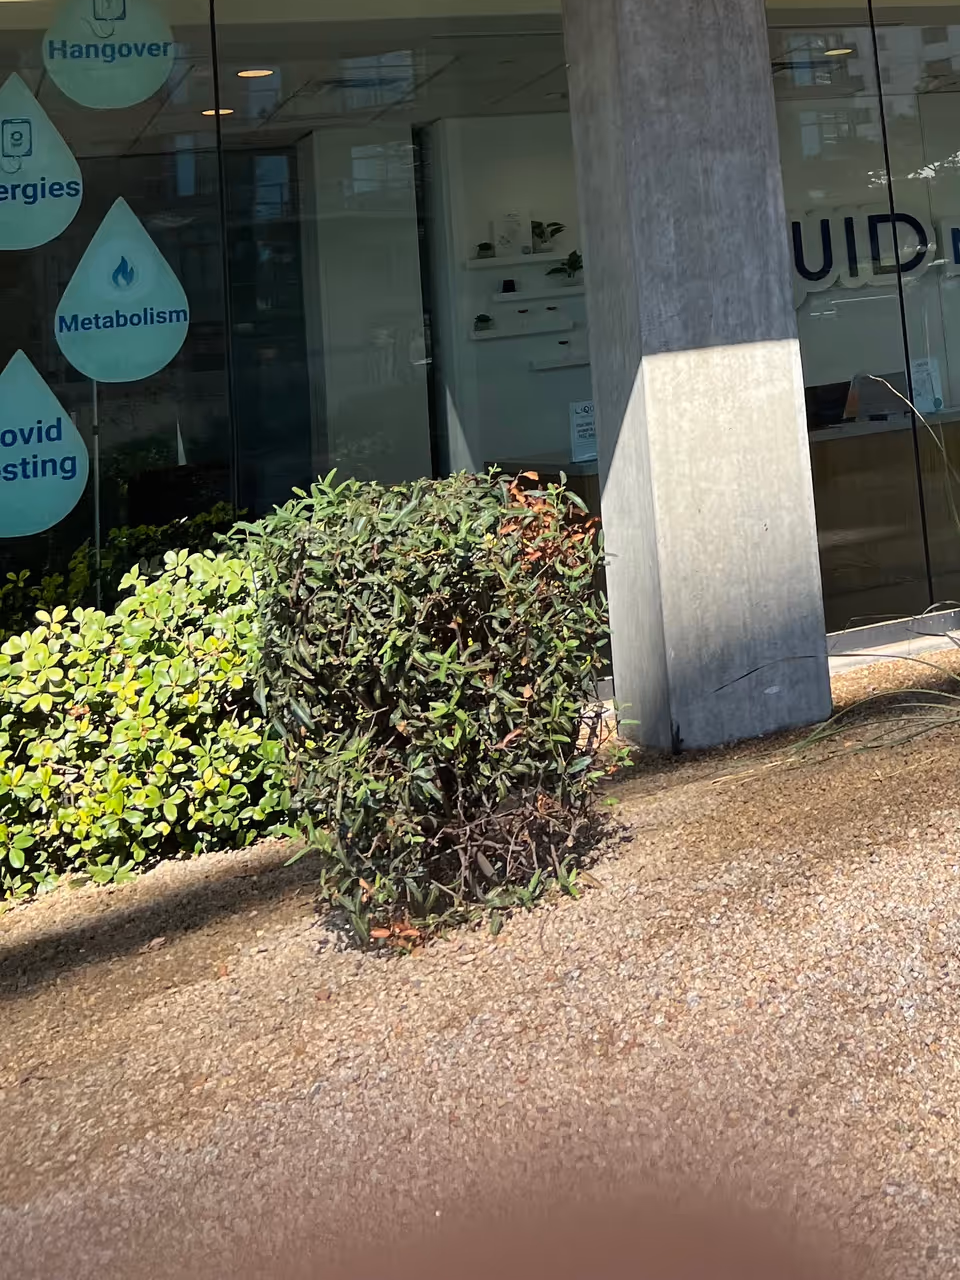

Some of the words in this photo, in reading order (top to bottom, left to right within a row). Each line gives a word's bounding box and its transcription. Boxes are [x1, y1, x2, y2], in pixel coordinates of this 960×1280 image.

[48, 40, 172, 63] Hangover
[58, 307, 188, 333] Metabolism
[0, 417, 63, 448] ovid
[0, 454, 77, 481] sting
